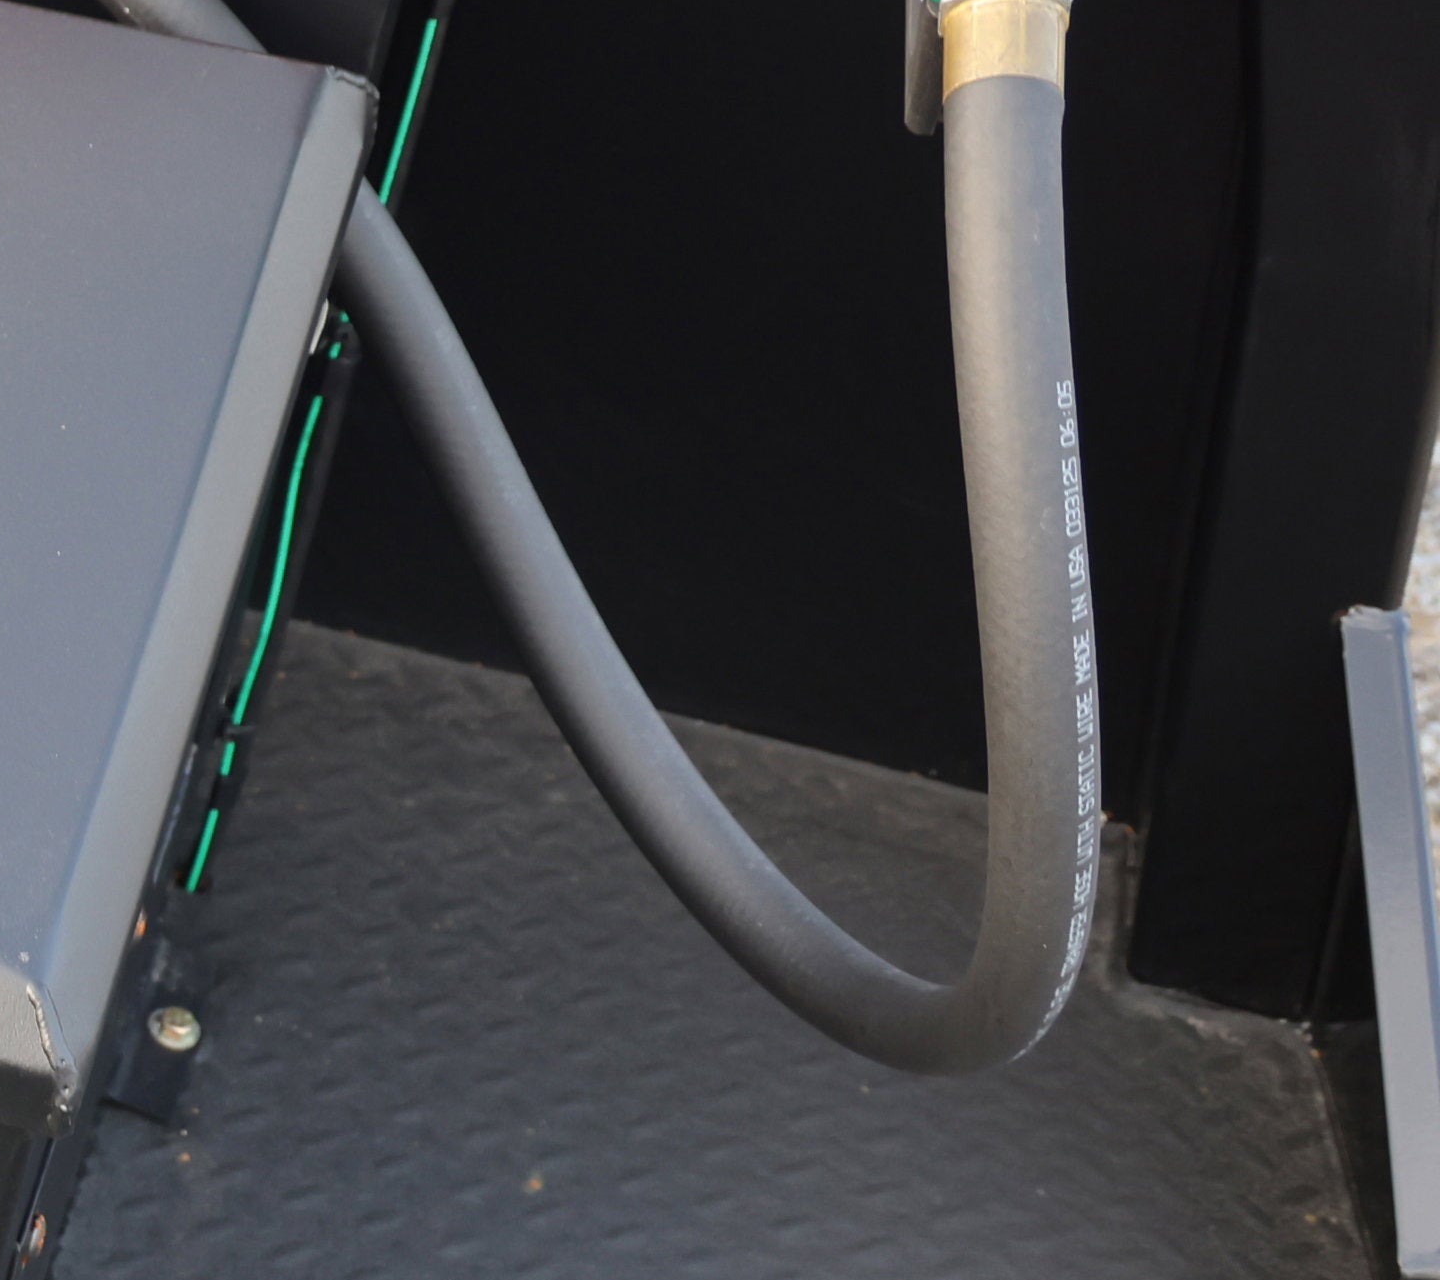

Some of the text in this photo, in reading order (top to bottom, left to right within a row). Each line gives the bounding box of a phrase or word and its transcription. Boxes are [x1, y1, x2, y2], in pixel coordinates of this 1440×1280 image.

[1056, 379, 1075, 448] 06:05
[1062, 456, 1082, 539] 033125
[1068, 544, 1086, 588] USA
[1071, 591, 1088, 623] IN
[1073, 629, 1091, 686] MADE
[1076, 687, 1094, 743] WIRE
[1078, 743, 1095, 816] STATIC
[1076, 817, 1095, 866] WITH
